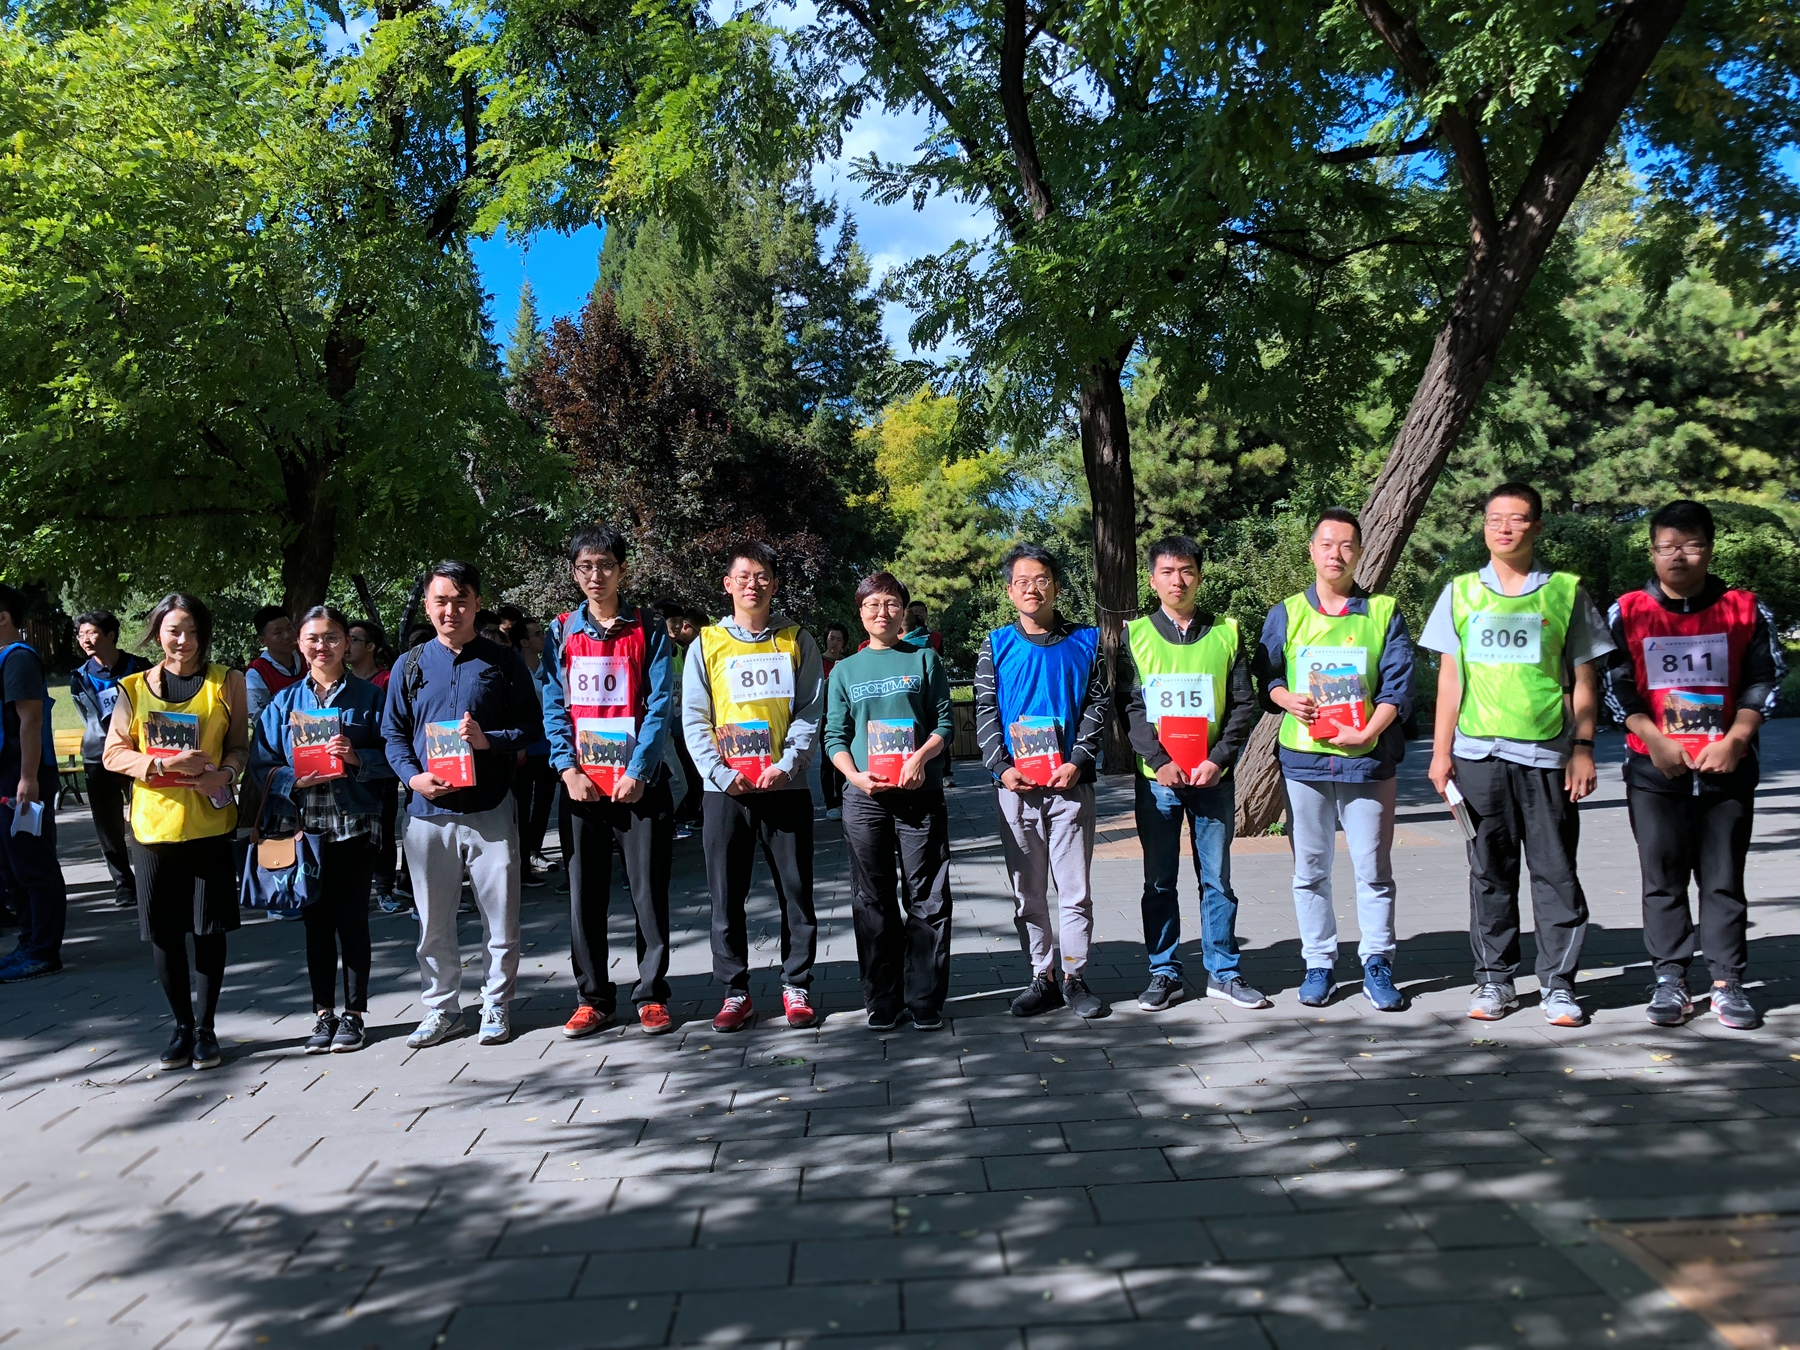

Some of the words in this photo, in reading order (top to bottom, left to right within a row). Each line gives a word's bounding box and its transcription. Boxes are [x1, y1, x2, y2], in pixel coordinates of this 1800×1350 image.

[1480, 628, 1528, 648] 806
[1662, 652, 1713, 673] 811
[578, 673, 617, 692] 810
[741, 668, 781, 688] 801
[852, 678, 918, 699] SPORTMAX
[103, 694, 118, 709] 80
[1160, 690, 1203, 708] 815
